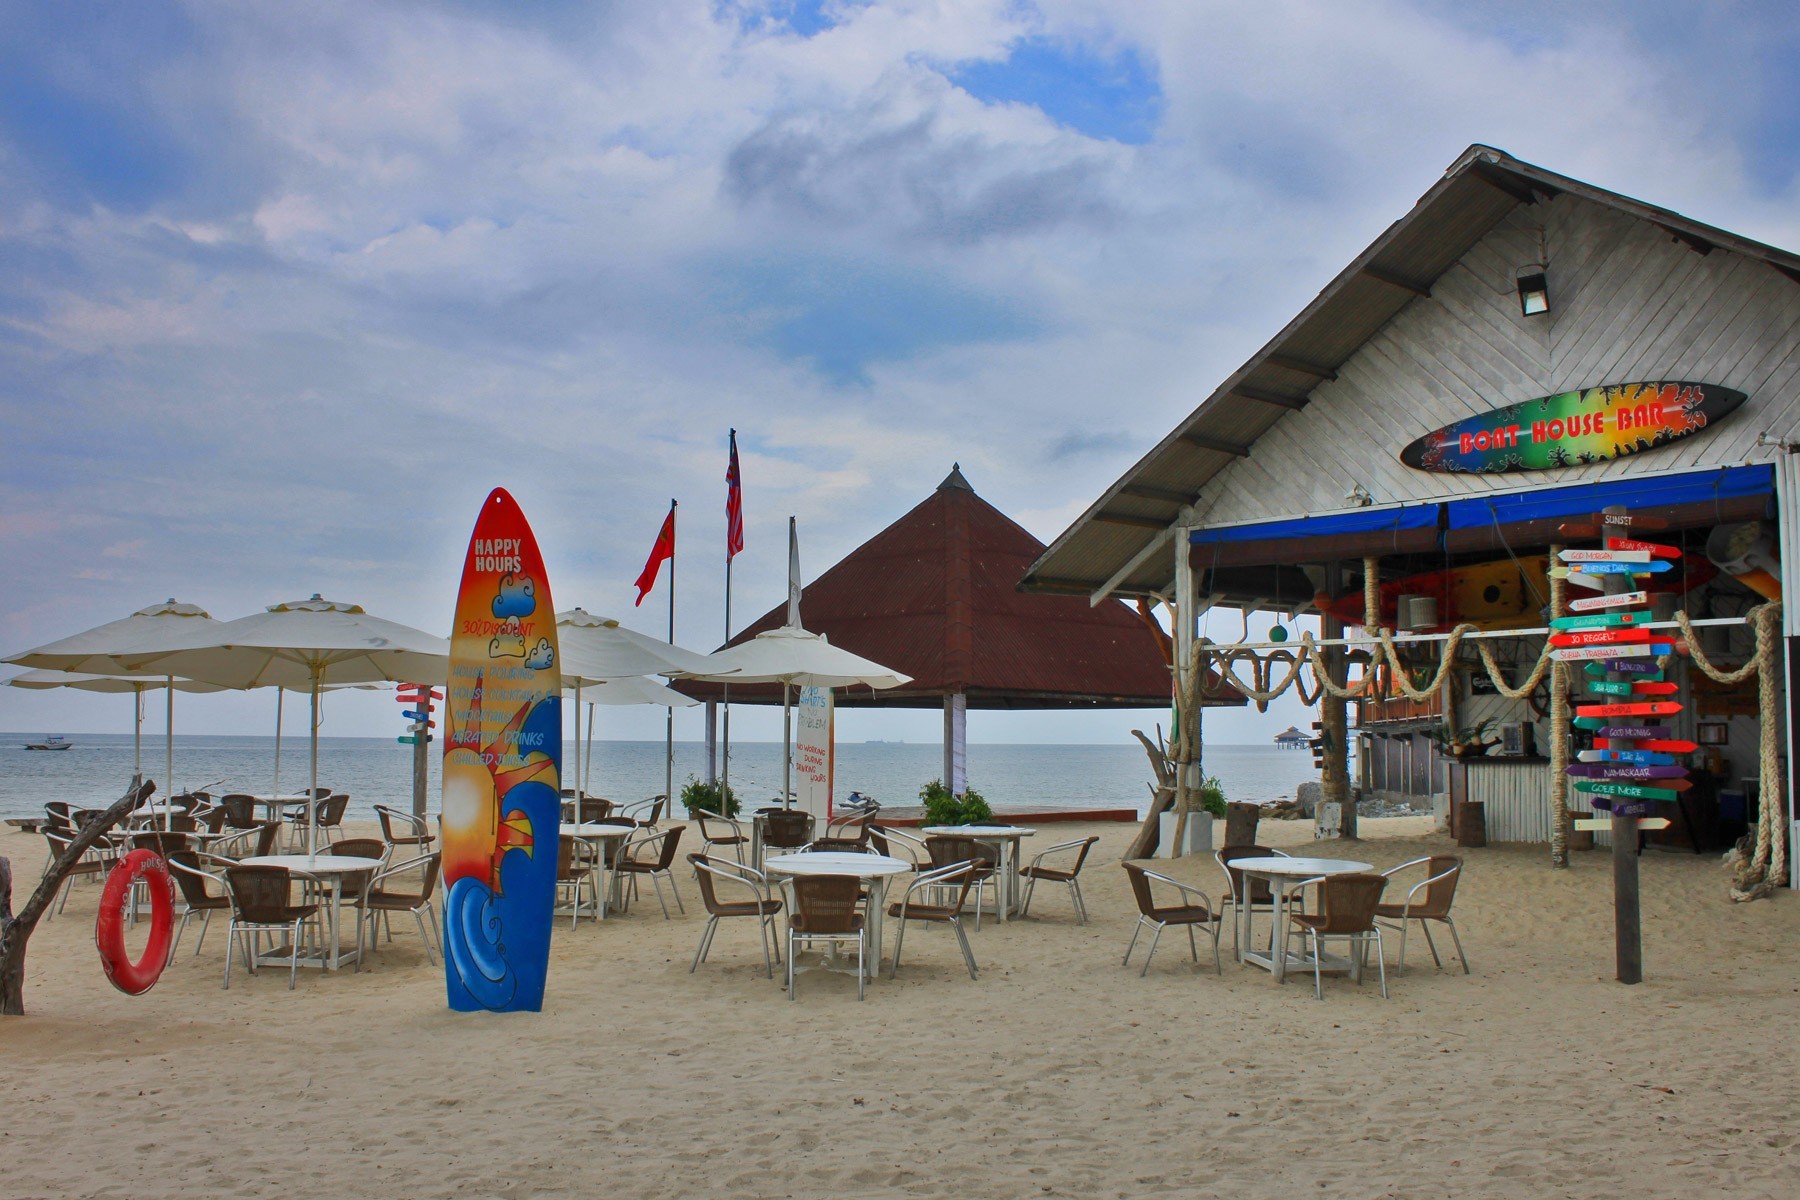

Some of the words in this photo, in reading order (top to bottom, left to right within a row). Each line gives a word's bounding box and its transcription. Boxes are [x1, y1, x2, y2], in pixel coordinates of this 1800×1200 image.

[1458, 423, 1519, 454] BOAT
[1531, 411, 1604, 444] HOUSE
[1616, 402, 1665, 431] BAR
[1604, 514, 1633, 526] SUNSET
[475, 538, 521, 556] HAPPY
[1585, 551, 1613, 561] MORGAN
[475, 556, 522, 573] HOURS
[1582, 564, 1611, 573] BUENOS
[1571, 634, 1581, 644] JO
[1583, 632, 1616, 643] REGGELT
[452, 664, 486, 679] HOUSE
[490, 666, 536, 681] POURING
[452, 686, 487, 700] HOUSE
[490, 688, 542, 703] COCKTAILS
[454, 709, 514, 723] MOCKTAILS
[450, 729, 500, 744] AERATED
[504, 731, 545, 746] DRINKS
[1609, 728, 1625, 737] GOOD
[803, 744, 826, 757] WORKING
[452, 751, 494, 766] CHILLED
[494, 753, 532, 768] JUICES
[804, 754, 823, 766] DURING
[1603, 768, 1651, 778] NAMASKAAR
[1617, 785, 1643, 796] MORE
[140, 857, 165, 873] HOUSE
